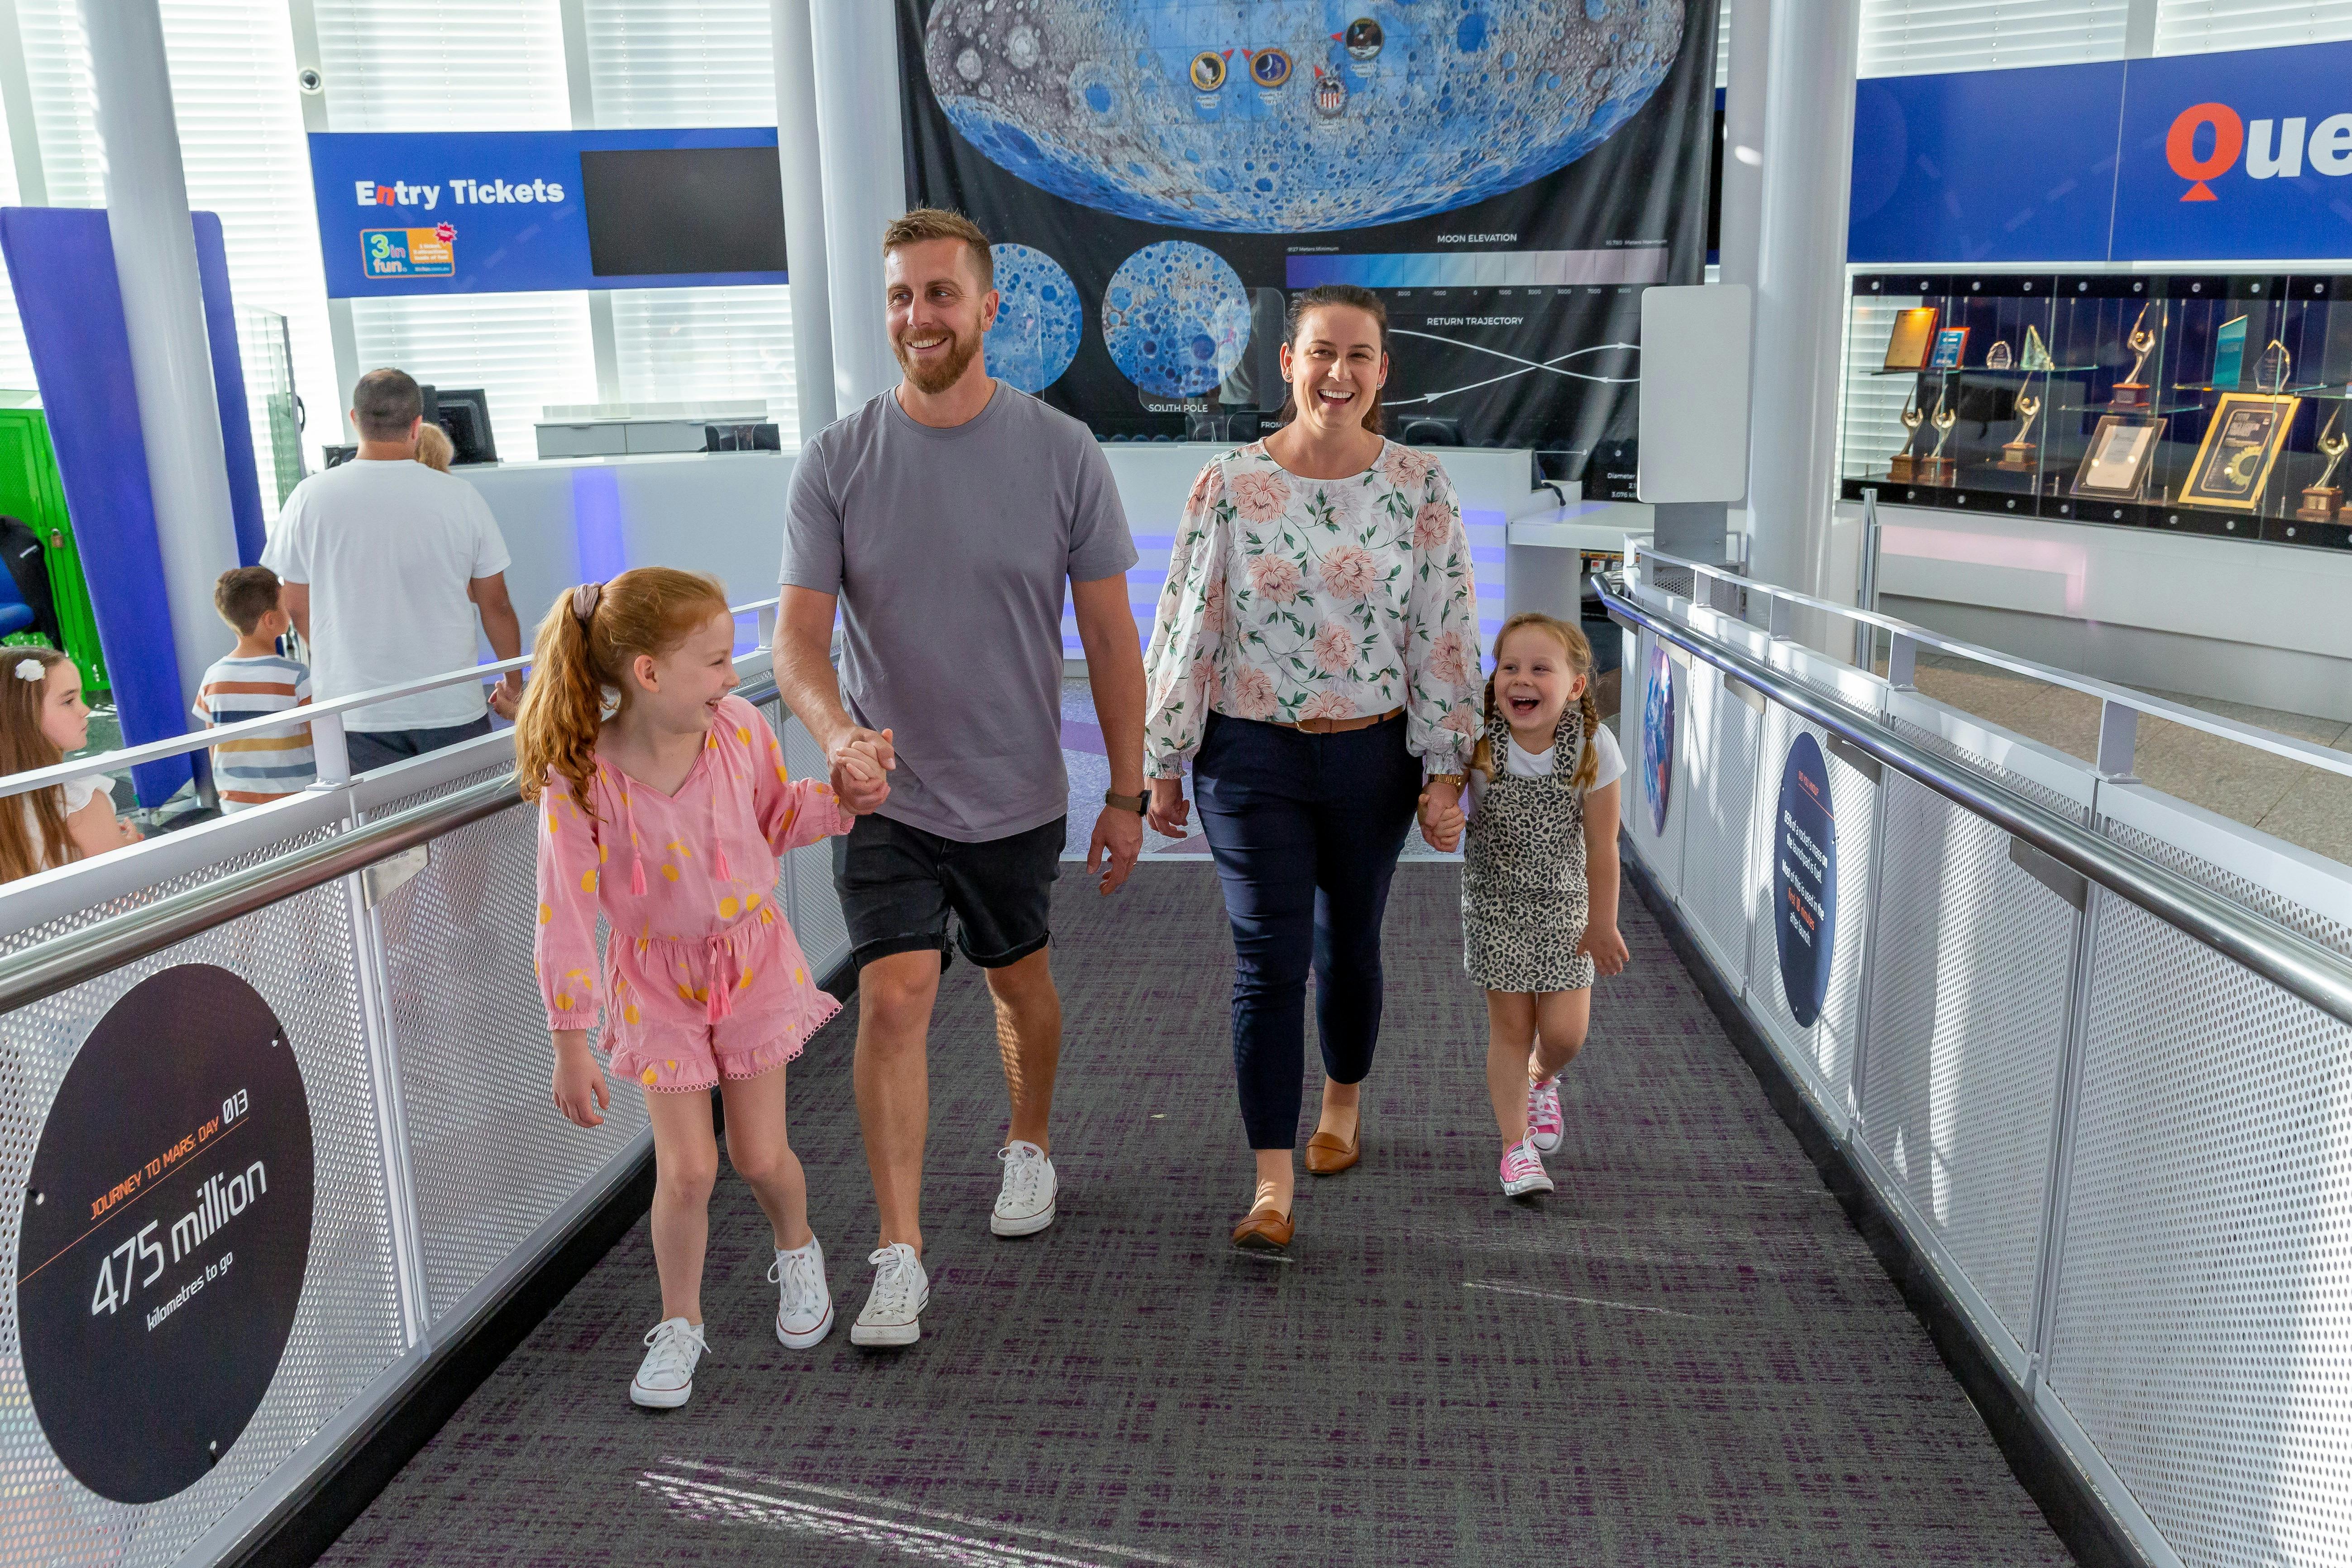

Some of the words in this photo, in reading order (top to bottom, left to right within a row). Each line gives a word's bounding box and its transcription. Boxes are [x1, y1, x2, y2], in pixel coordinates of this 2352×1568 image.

[2165, 102, 2352, 201] Que
[355, 180, 440, 210] Entry
[449, 178, 565, 205] Tickets
[371, 234, 390, 259] 3
[390, 244, 406, 258] in
[1437, 234, 1466, 243] MOON
[1468, 233, 1517, 243] ELEVATION
[1427, 317, 1463, 325] RETURN
[1466, 317, 1524, 325] TRAJECTORY
[1149, 404, 1181, 412] SOUTH
[1184, 404, 1208, 412] POLE
[1792, 820, 1797, 832] of
[1796, 825, 1799, 836] a
[1812, 843, 1822, 862] mass
[1822, 855, 1828, 868] on
[1782, 859, 1791, 879] Most
[1790, 871, 1795, 884] of
[1801, 881, 1804, 896] is
[1804, 889, 1814, 907] used
[1813, 896, 1817, 913] in
[1810, 859, 1814, 874] is
[91, 1169, 142, 1220] JOURNEY
[144, 1157, 161, 1179] TO
[163, 1133, 196, 1168] MARS:
[198, 1115, 219, 1143] DAY
[222, 1088, 249, 1124] 013
[91, 1219, 164, 1316] 475
[171, 1160, 267, 1263] million
[146, 1275, 204, 1332] kilometres
[206, 1264, 218, 1282] to
[220, 1252, 233, 1276] go
